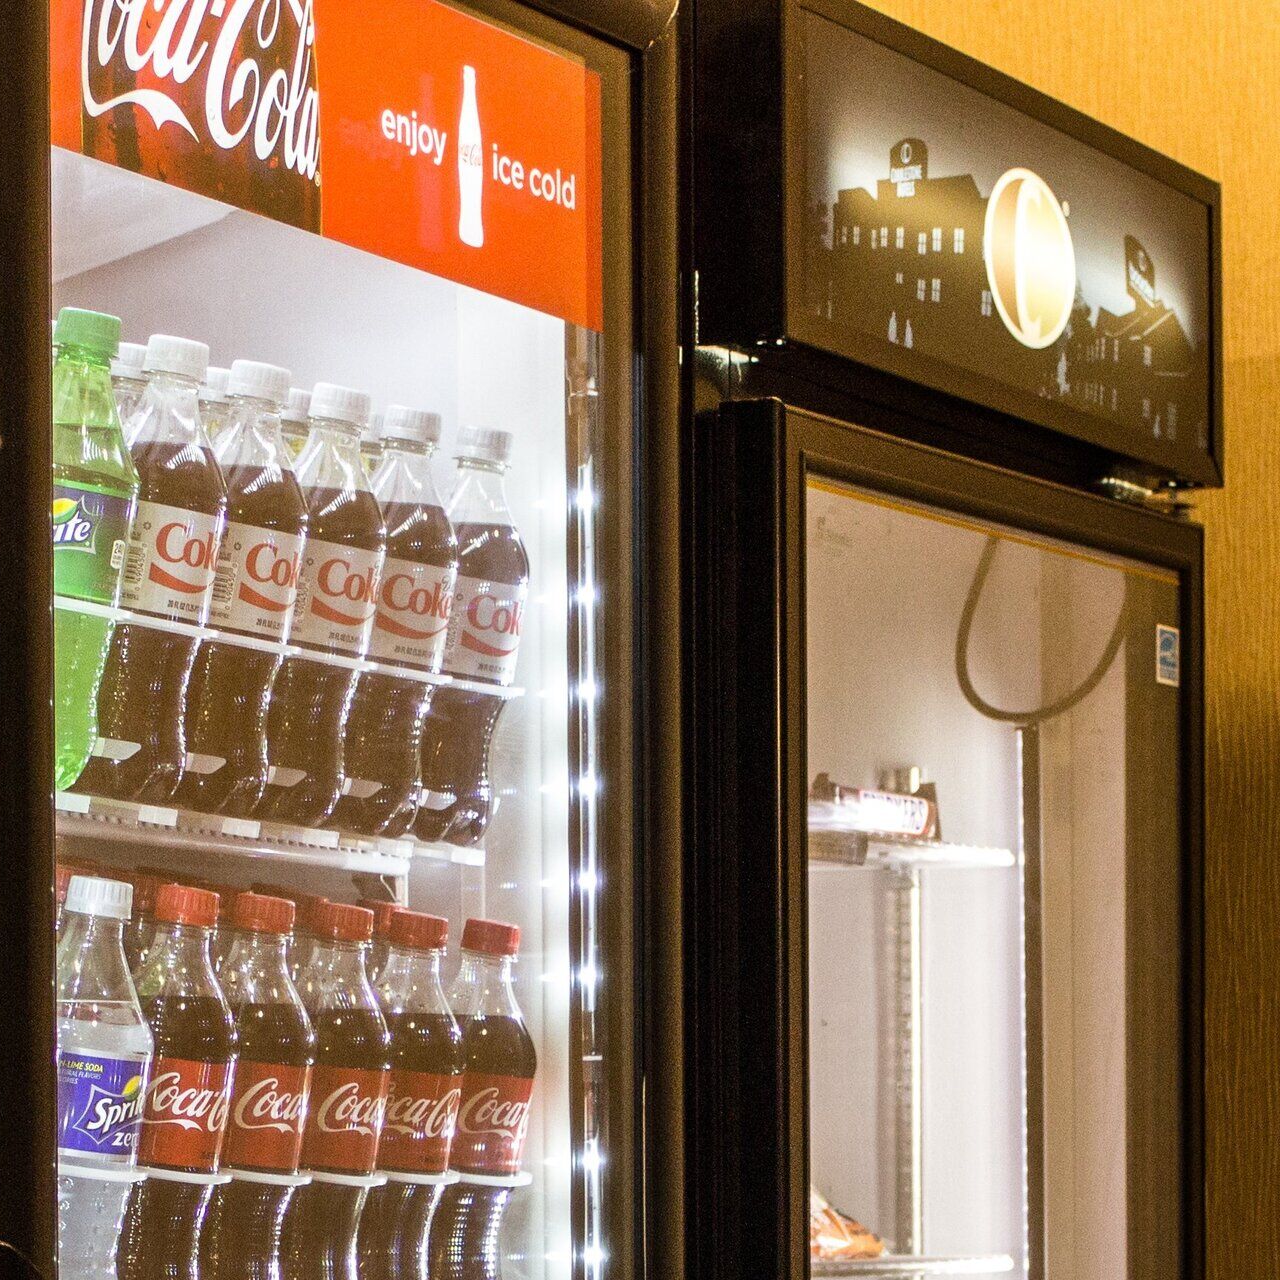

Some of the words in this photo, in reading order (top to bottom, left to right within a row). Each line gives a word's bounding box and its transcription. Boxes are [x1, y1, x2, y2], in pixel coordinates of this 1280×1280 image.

[381, 108, 447, 166] enjoy
[491, 143, 525, 190] ice
[529, 166, 576, 210] cold
[84, 1062, 104, 1074] SODA
[86, 1094, 146, 1134] Sprit
[111, 1131, 139, 1147] zer
